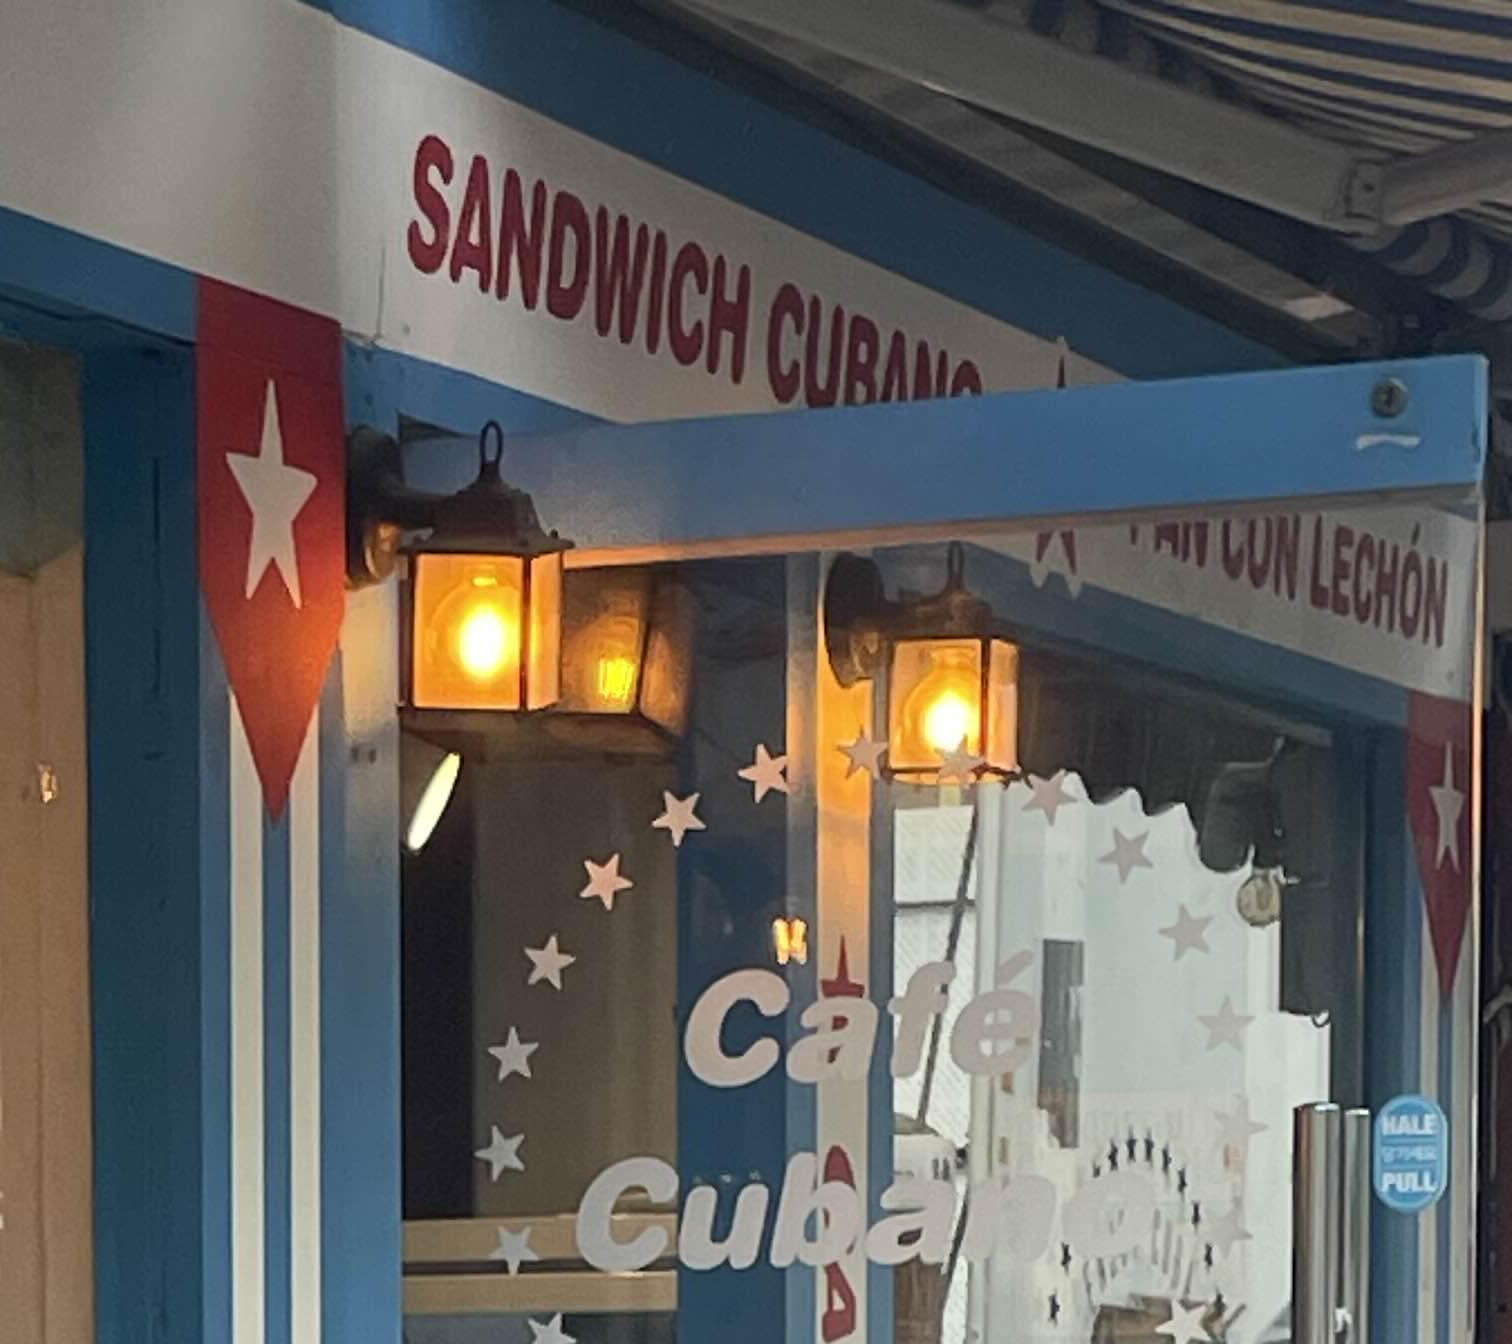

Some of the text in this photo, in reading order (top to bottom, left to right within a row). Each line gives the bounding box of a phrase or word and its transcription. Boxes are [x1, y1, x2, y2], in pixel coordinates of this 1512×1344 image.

[407, 133, 751, 386] SANDWICH
[1309, 513, 1449, 649] LECHÓN
[684, 951, 1040, 1089] Café
[575, 1151, 1159, 1274] Cubano
[1381, 1171, 1439, 1193] PULL
